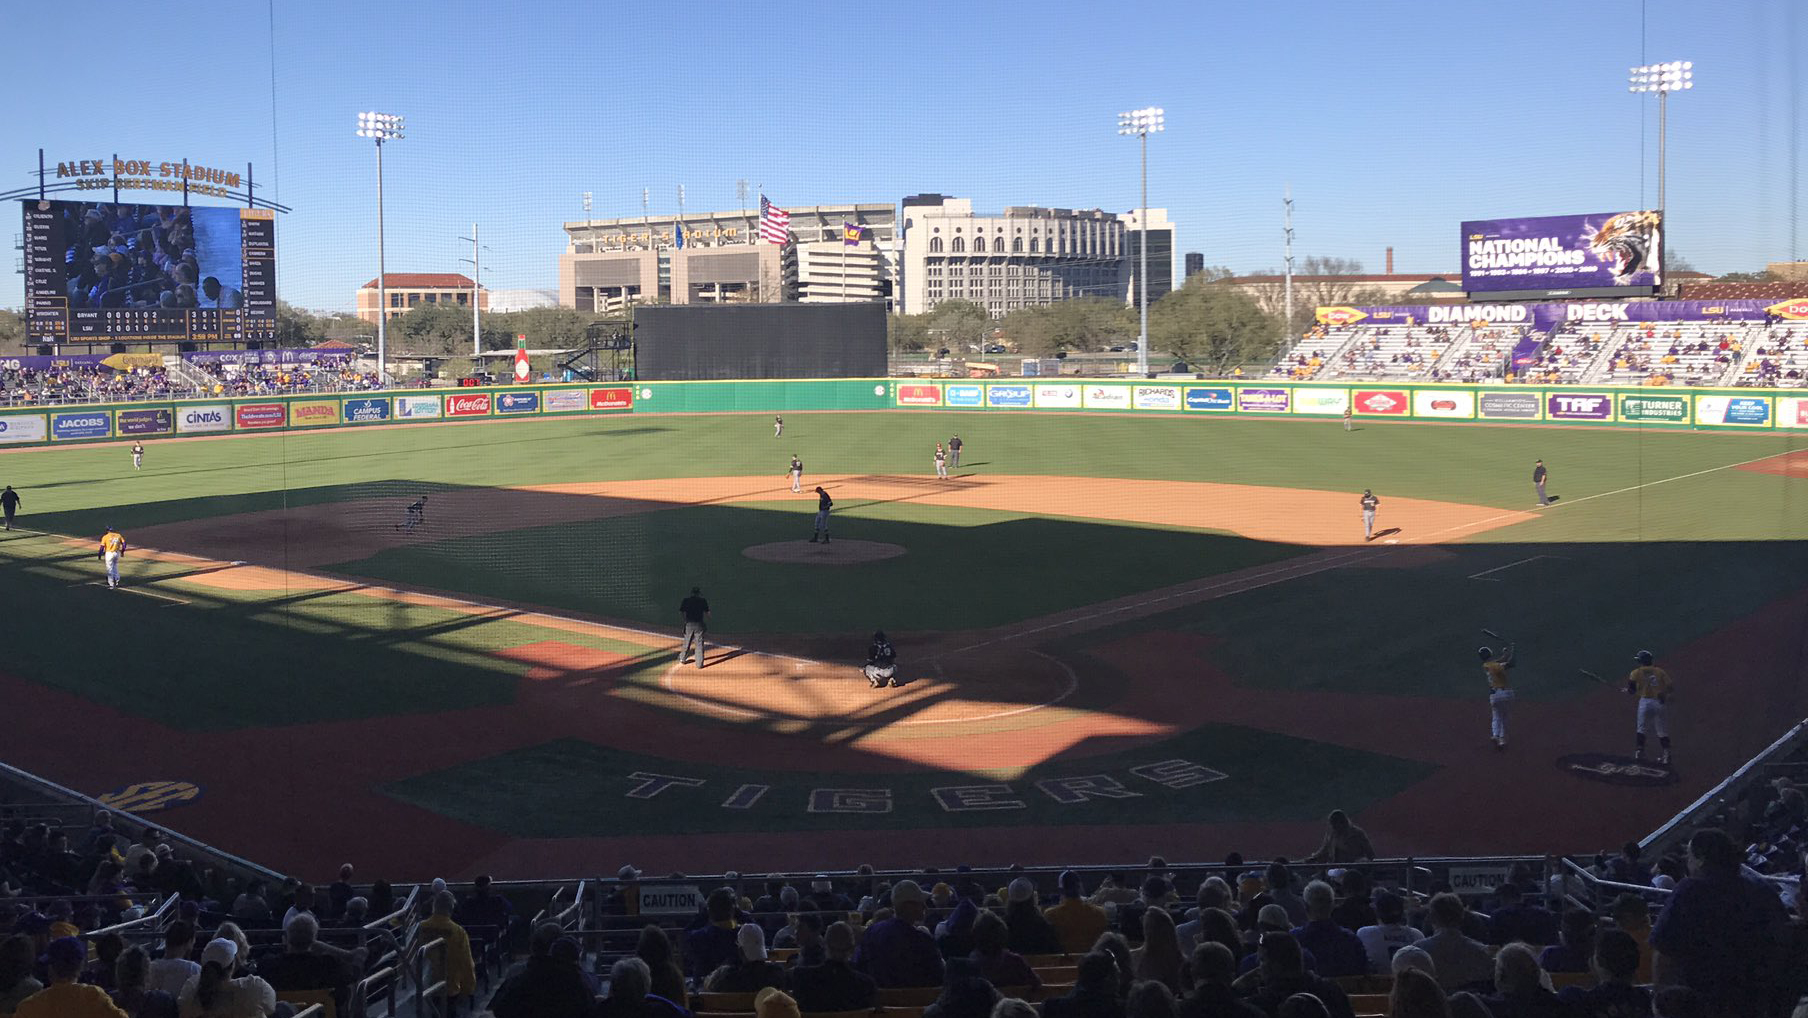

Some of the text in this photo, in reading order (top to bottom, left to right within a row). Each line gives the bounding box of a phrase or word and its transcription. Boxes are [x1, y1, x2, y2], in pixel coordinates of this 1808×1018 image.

[57, 160, 241, 188] ALEX BOX STADIUM
[603, 227, 736, 244] TIGER SADIUM
[1469, 237, 1563, 255] NATIONAL
[1468, 250, 1586, 268] CHAMPIONS
[1429, 306, 1526, 322] DIAMOND
[1568, 304, 1629, 320] DECK
[1138, 388, 1175, 399] RICHARDS
[296, 406, 336, 418] MANDA
[456, 397, 488, 412] Coca-Cola
[1642, 401, 1682, 409] TURNER
[59, 418, 104, 428] JACOBS
[625, 759, 1229, 813] TIGERS
[643, 894, 696, 907] CAUTION
